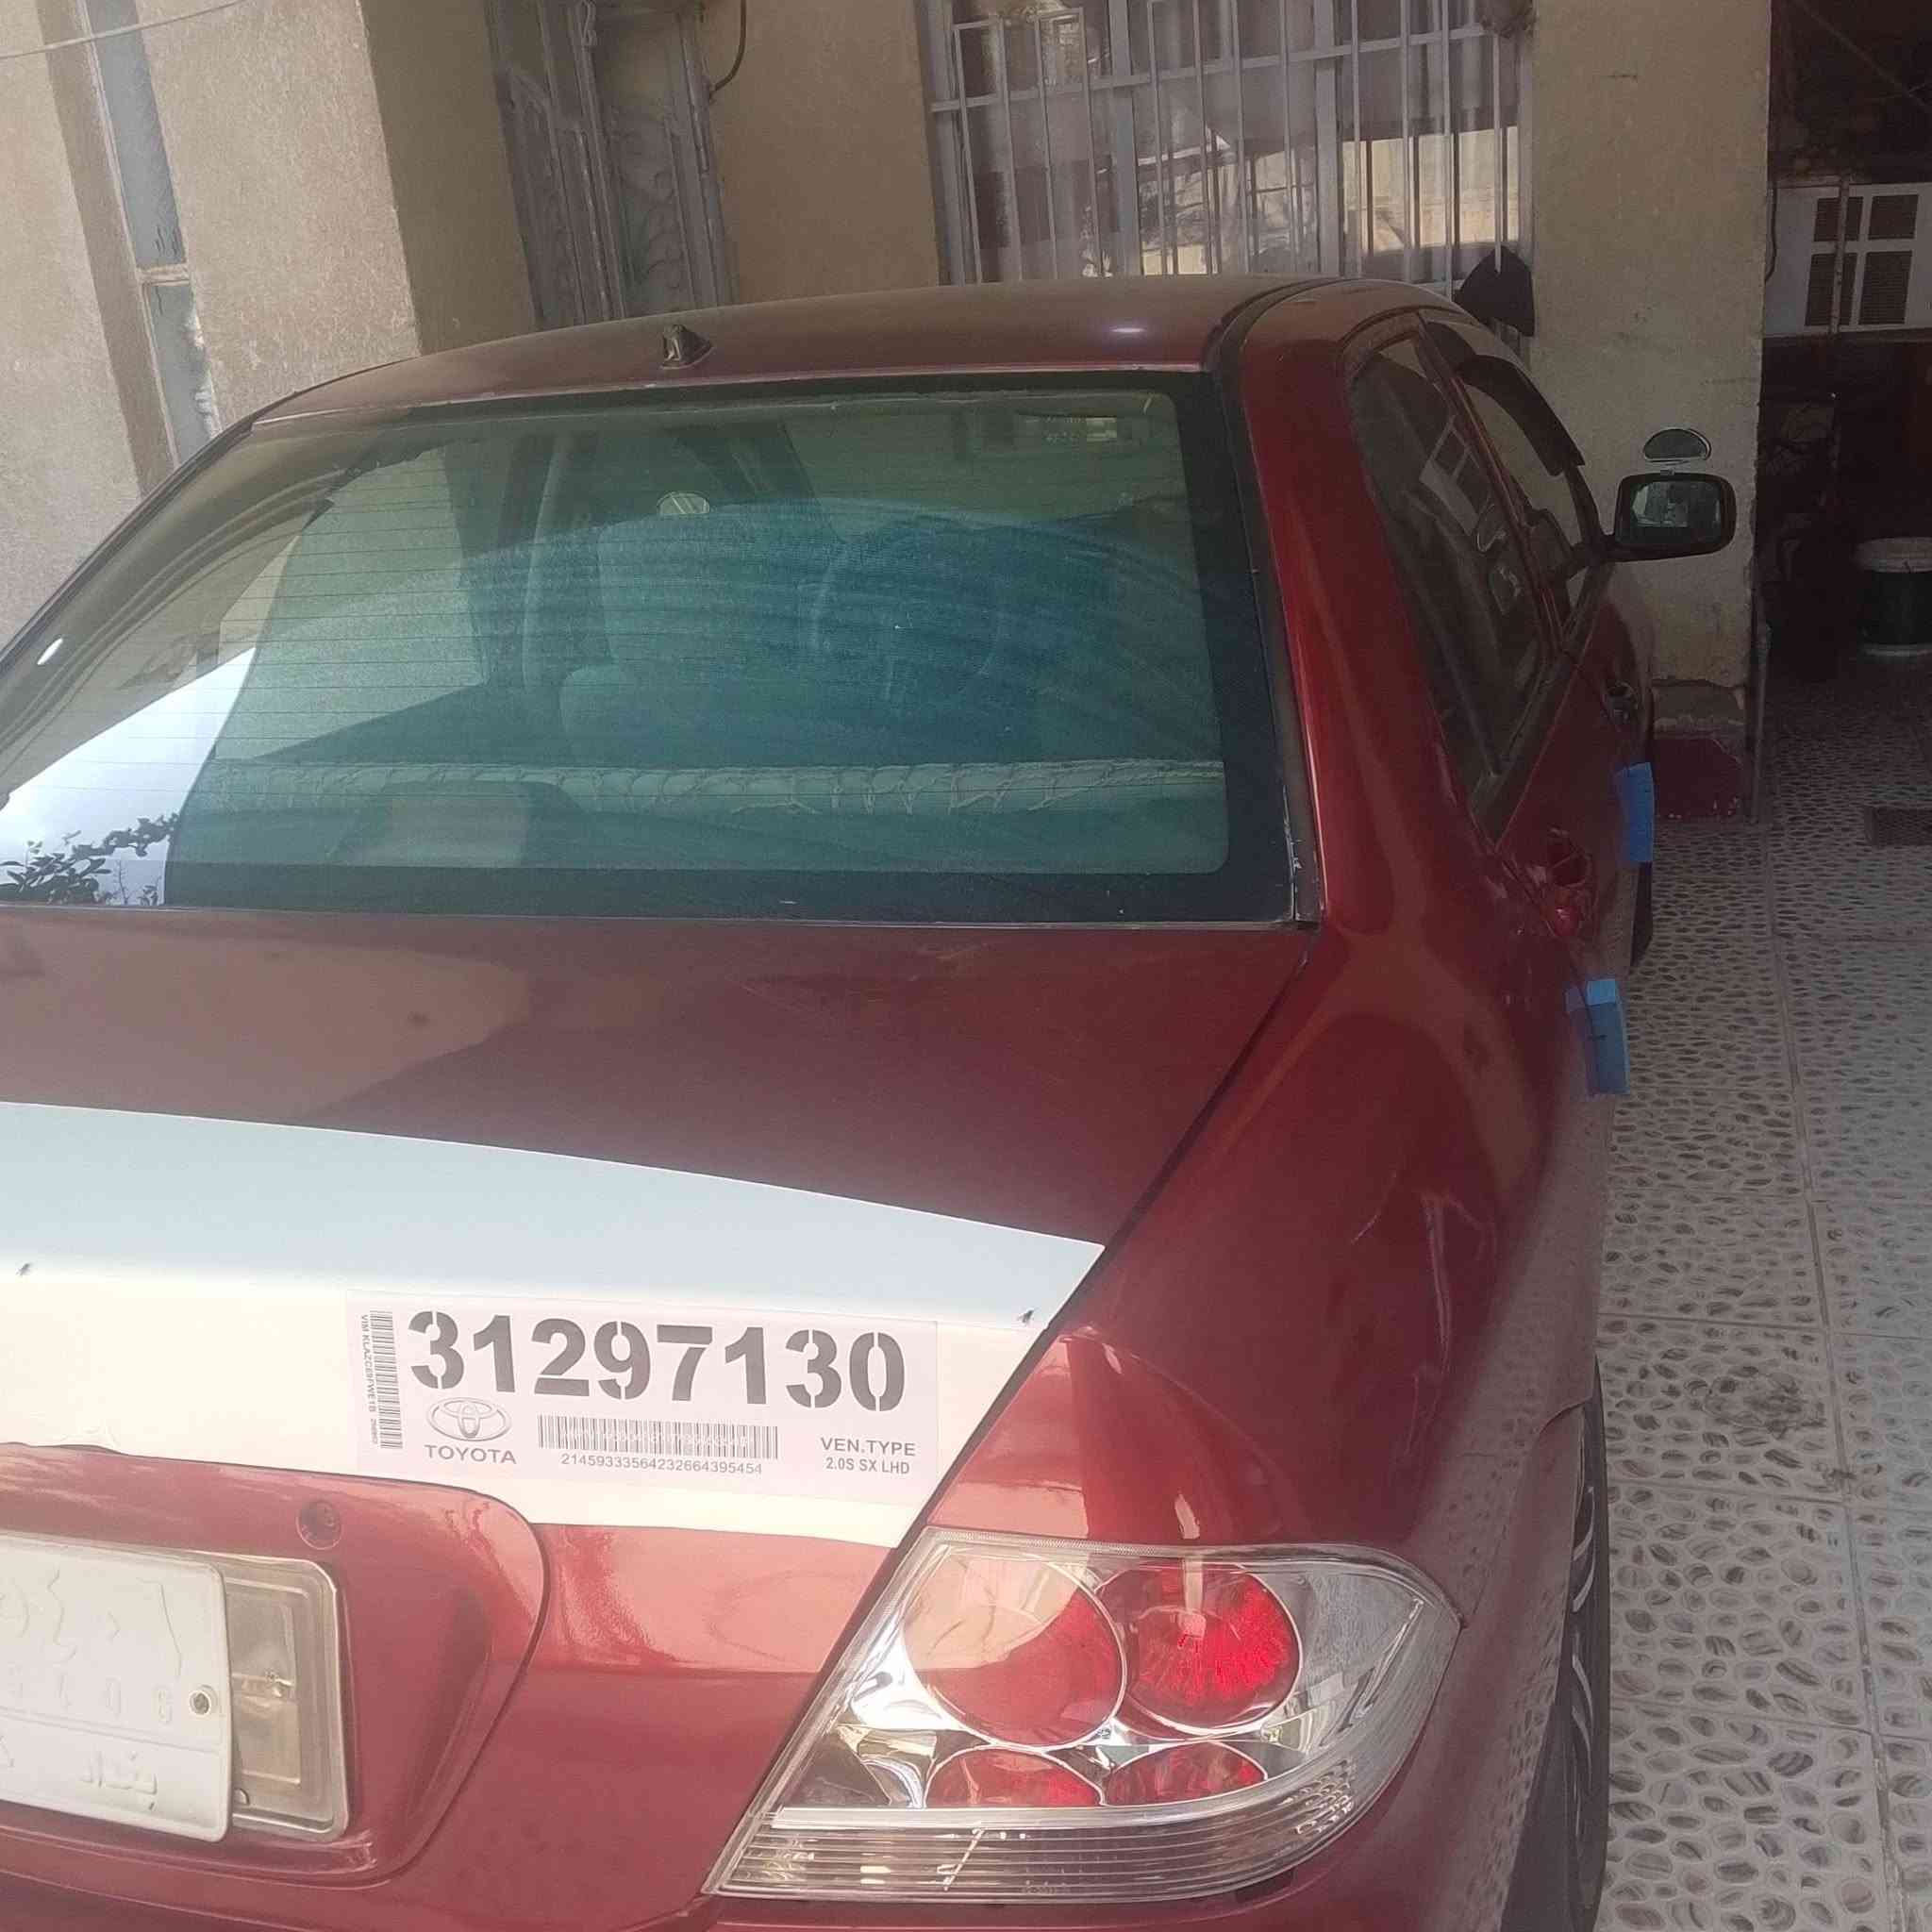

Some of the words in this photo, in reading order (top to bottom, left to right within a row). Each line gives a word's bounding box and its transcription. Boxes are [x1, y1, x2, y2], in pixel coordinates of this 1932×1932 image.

[408, 1309, 906, 1413] 31297130
[424, 1444, 517, 1465] TOYOTA
[820, 1437, 916, 1457] VEN.TYPE
[825, 1457, 855, 1472] 2.0S
[859, 1458, 877, 1473] SX
[881, 1459, 910, 1474] LHD
